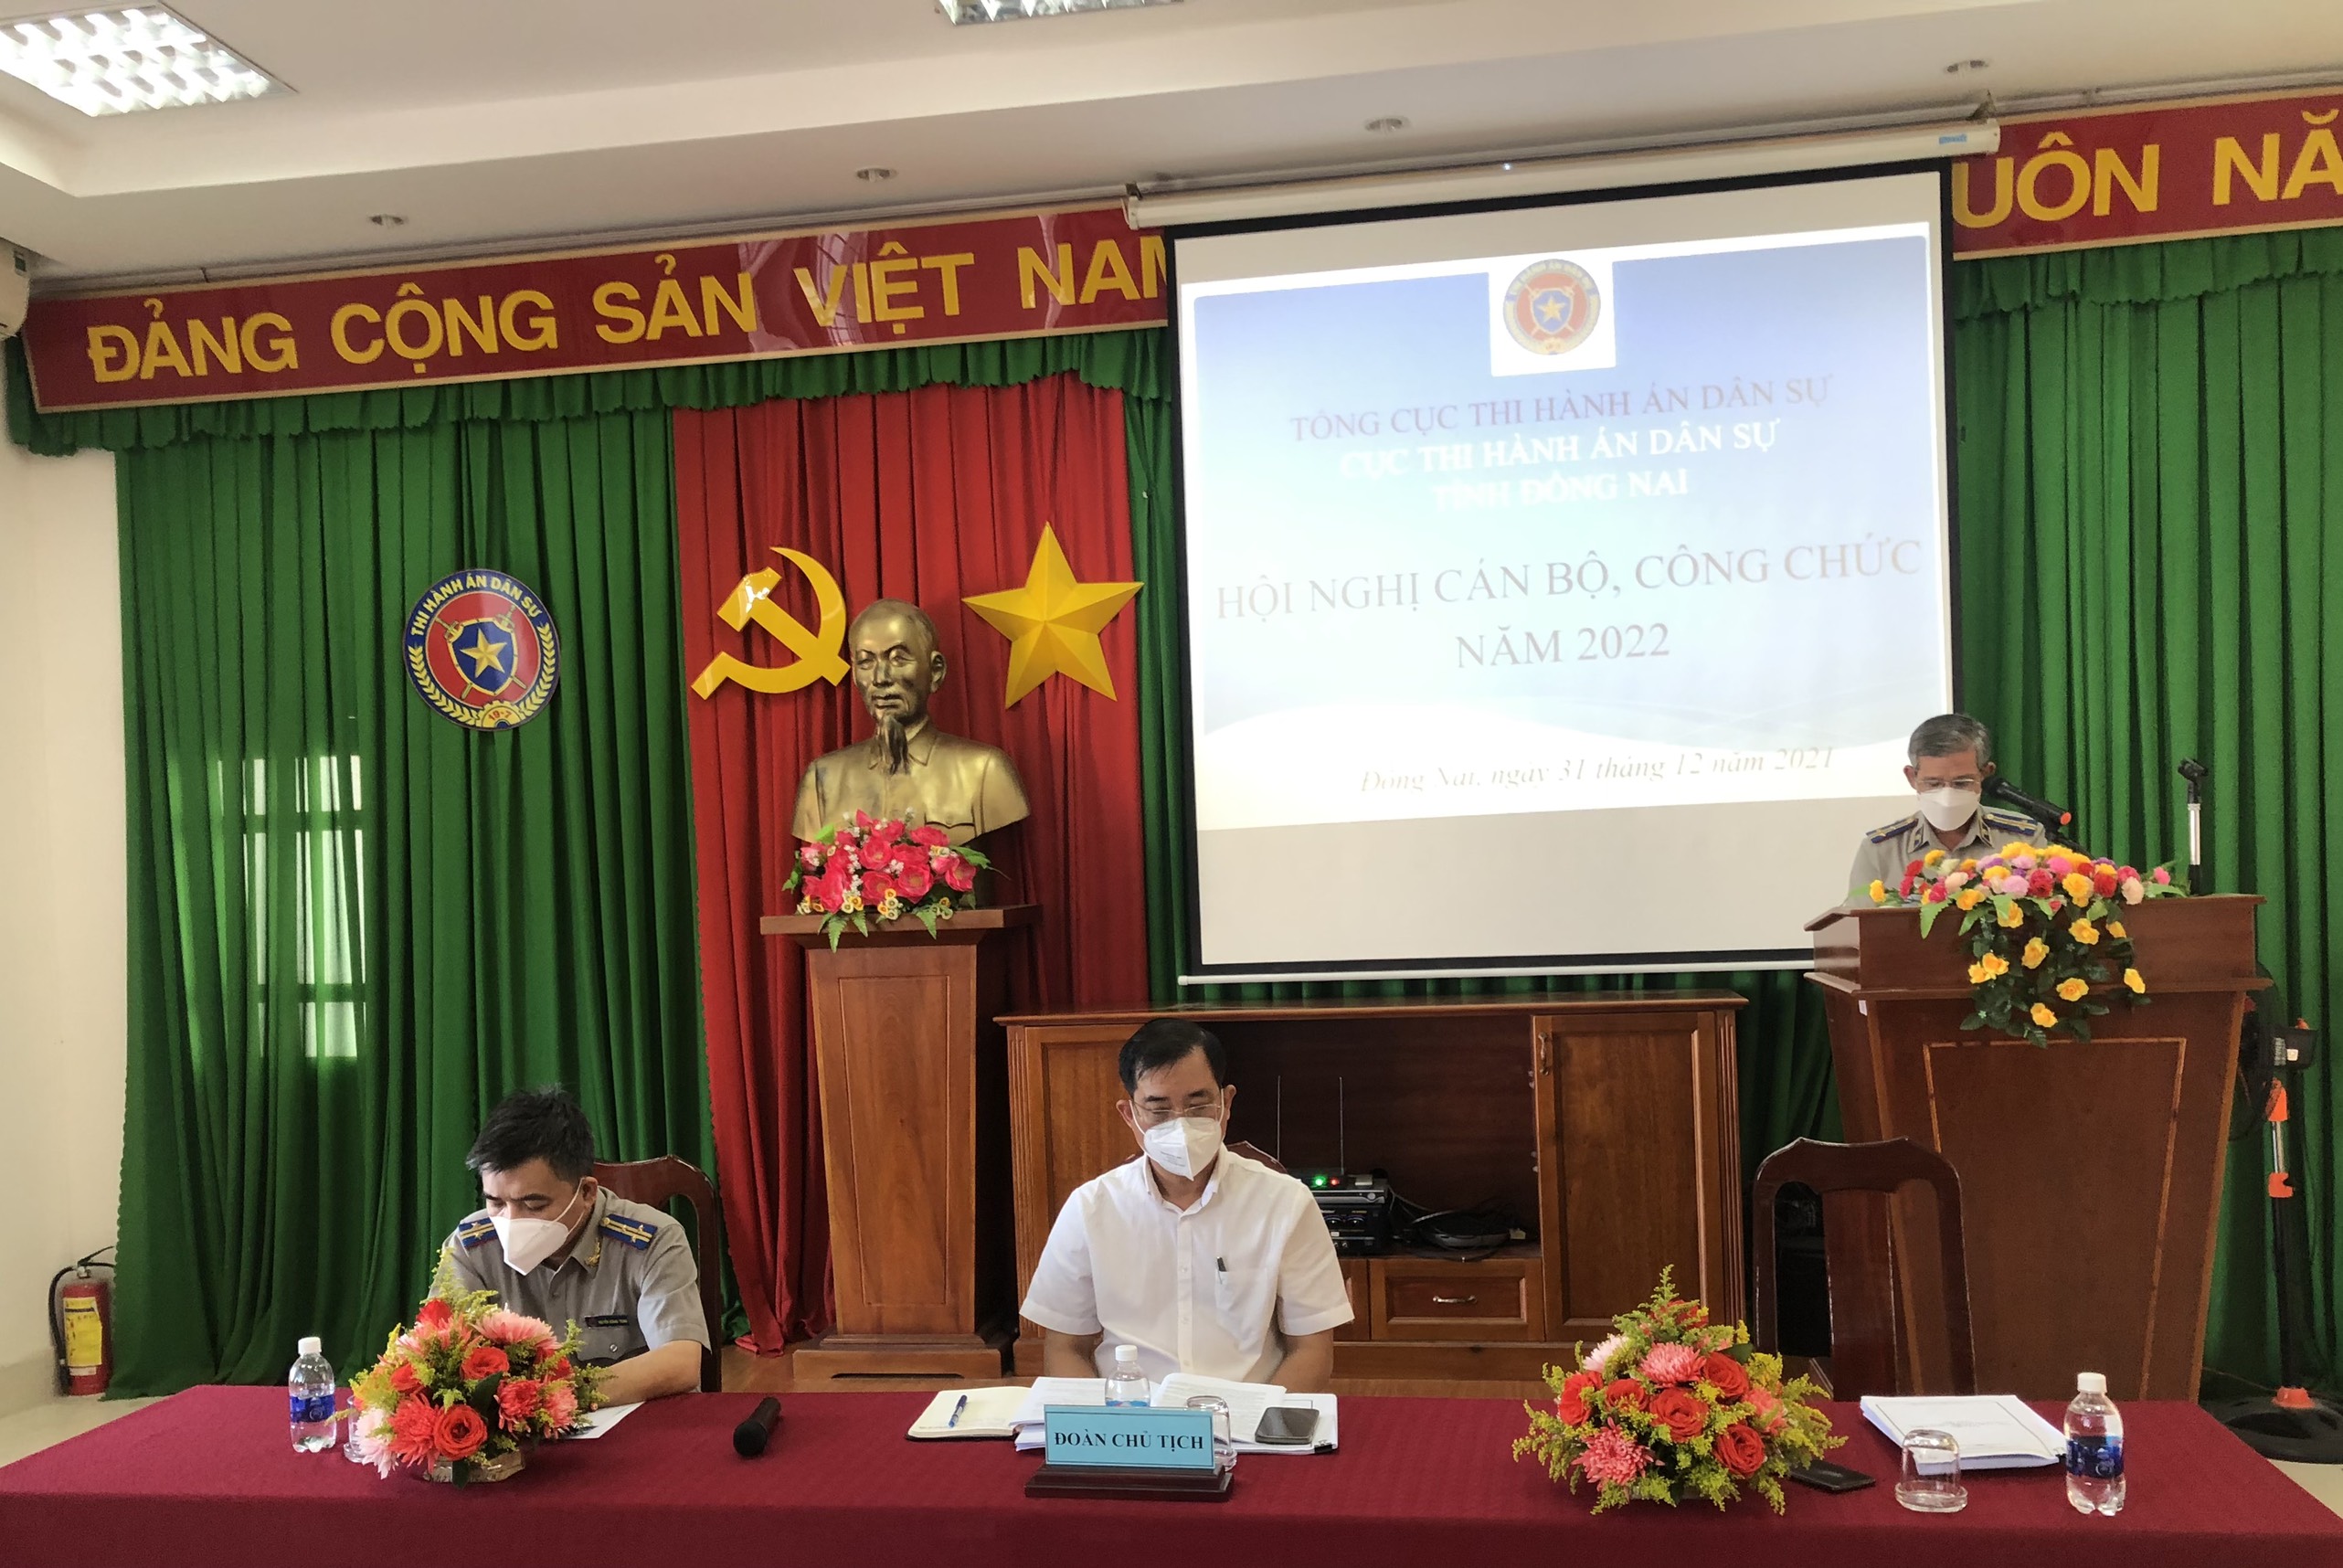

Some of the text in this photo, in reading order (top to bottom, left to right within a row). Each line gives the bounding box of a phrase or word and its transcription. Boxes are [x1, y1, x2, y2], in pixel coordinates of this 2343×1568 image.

[86, 298, 299, 383] ĐẢNG
[330, 282, 558, 374] CỘNG
[593, 254, 758, 344] SẢN
[794, 241, 974, 335] VIỆT
[1390, 404, 1458, 437] CỤC
[1468, 398, 1524, 427] THI
[1534, 388, 1630, 423] HÀNH
[1642, 380, 1689, 414] ÁN
[1702, 376, 1776, 410] DÂN
[1786, 373, 1834, 408] SỰ
[1416, 441, 1475, 472] THI
[1483, 432, 1579, 468] HÀNH
[1590, 426, 1638, 459] ÁN
[1649, 419, 1722, 455] DÂN
[1733, 417, 1781, 452] SỰ
[1627, 467, 1689, 498] NAI
[411, 611, 429, 636] THI
[423, 578, 464, 614] HÀNH
[466, 573, 488, 589] ÁN
[491, 577, 523, 601] DÂN
[1216, 532, 1923, 623] HỘI NGHỊ CÁN BỘ, CÔNG CHỨC
[1455, 621, 1670, 669] NĂM 2022
[1558, 758, 1586, 781] 31
[1596, 755, 1667, 782] tháng
[1676, 752, 1703, 776] 12
[1712, 750, 1765, 773] năm
[1774, 745, 1835, 770] 2021
[1054, 1428, 1203, 1452] ĐOÀN CHỦ TỊCH
